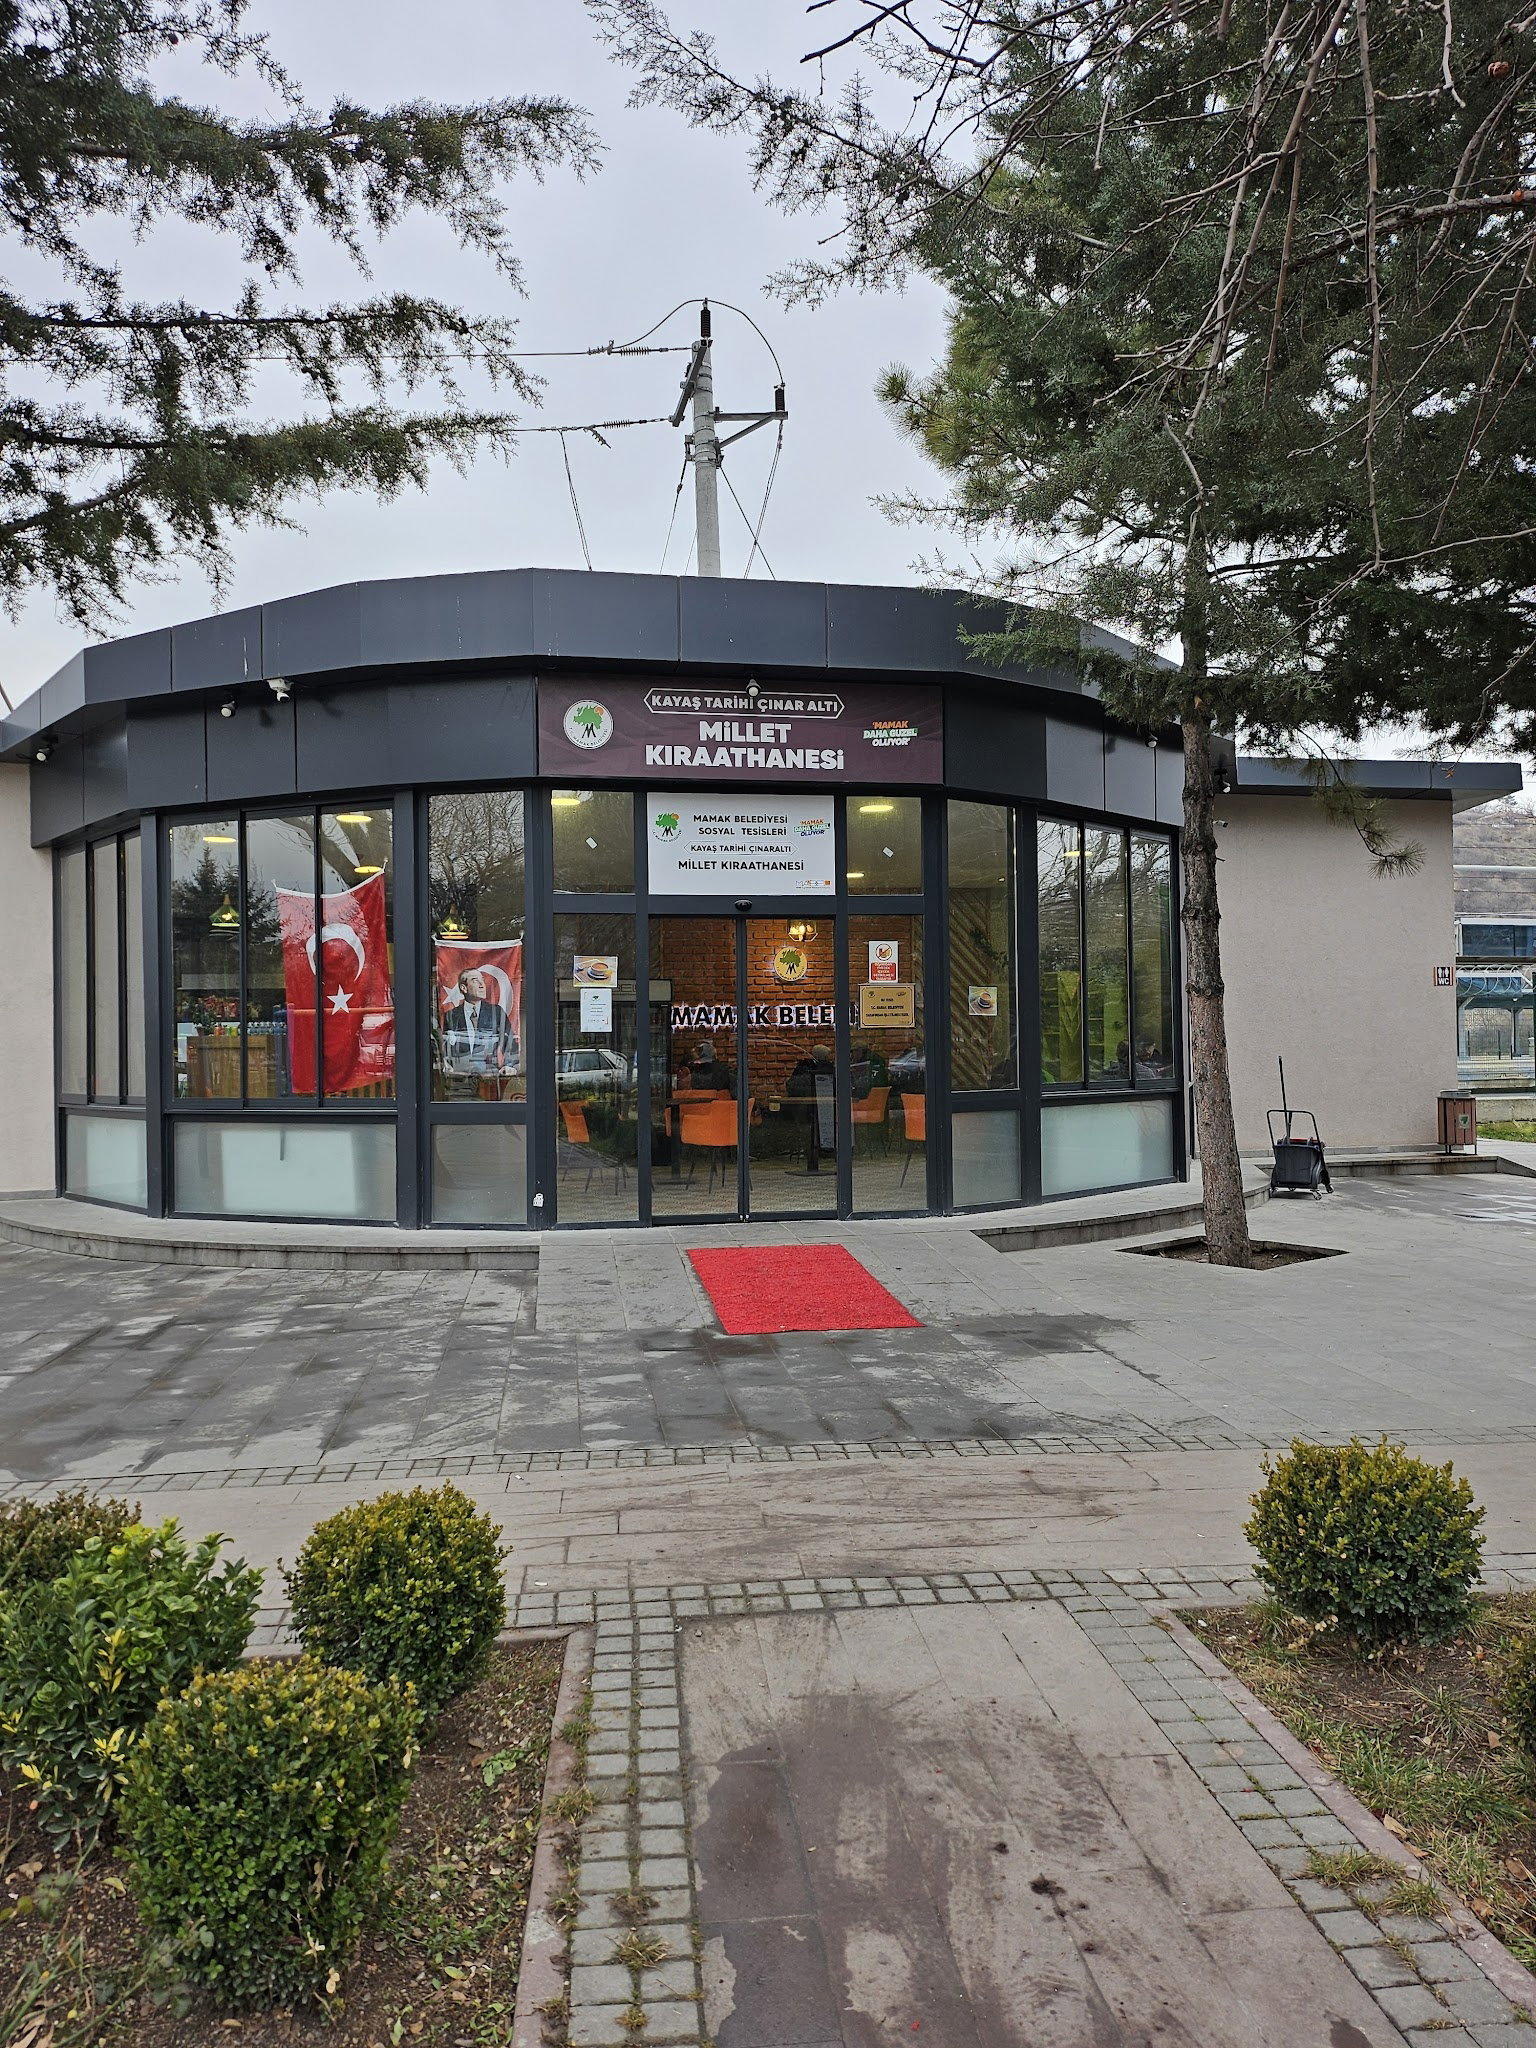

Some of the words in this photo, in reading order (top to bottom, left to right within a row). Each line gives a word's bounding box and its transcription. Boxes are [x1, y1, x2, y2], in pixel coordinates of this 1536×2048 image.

[651, 695, 701, 711] KAYAŞ
[704, 694, 754, 710] TARİHİ
[757, 698, 804, 713] ÇINAR
[807, 700, 838, 712] ALTI
[699, 720, 792, 744] MİLLET
[645, 744, 845, 770] KIRAATHANESİ
[693, 814, 731, 823] MAMAK
[734, 813, 788, 824] BELEDİYESİ
[698, 827, 735, 835] SOSYAL
[741, 826, 787, 836] TESİSLERİ
[691, 845, 717, 853] KAYAŞ
[720, 844, 746, 852] TARİHİ
[749, 845, 791, 853] ÇINARALTI
[678, 858, 717, 870] MİLLET
[721, 860, 804, 871] KIRAATHANESİ
[1438, 977, 1450, 985] WC
[672, 1006, 771, 1025] MAMK
